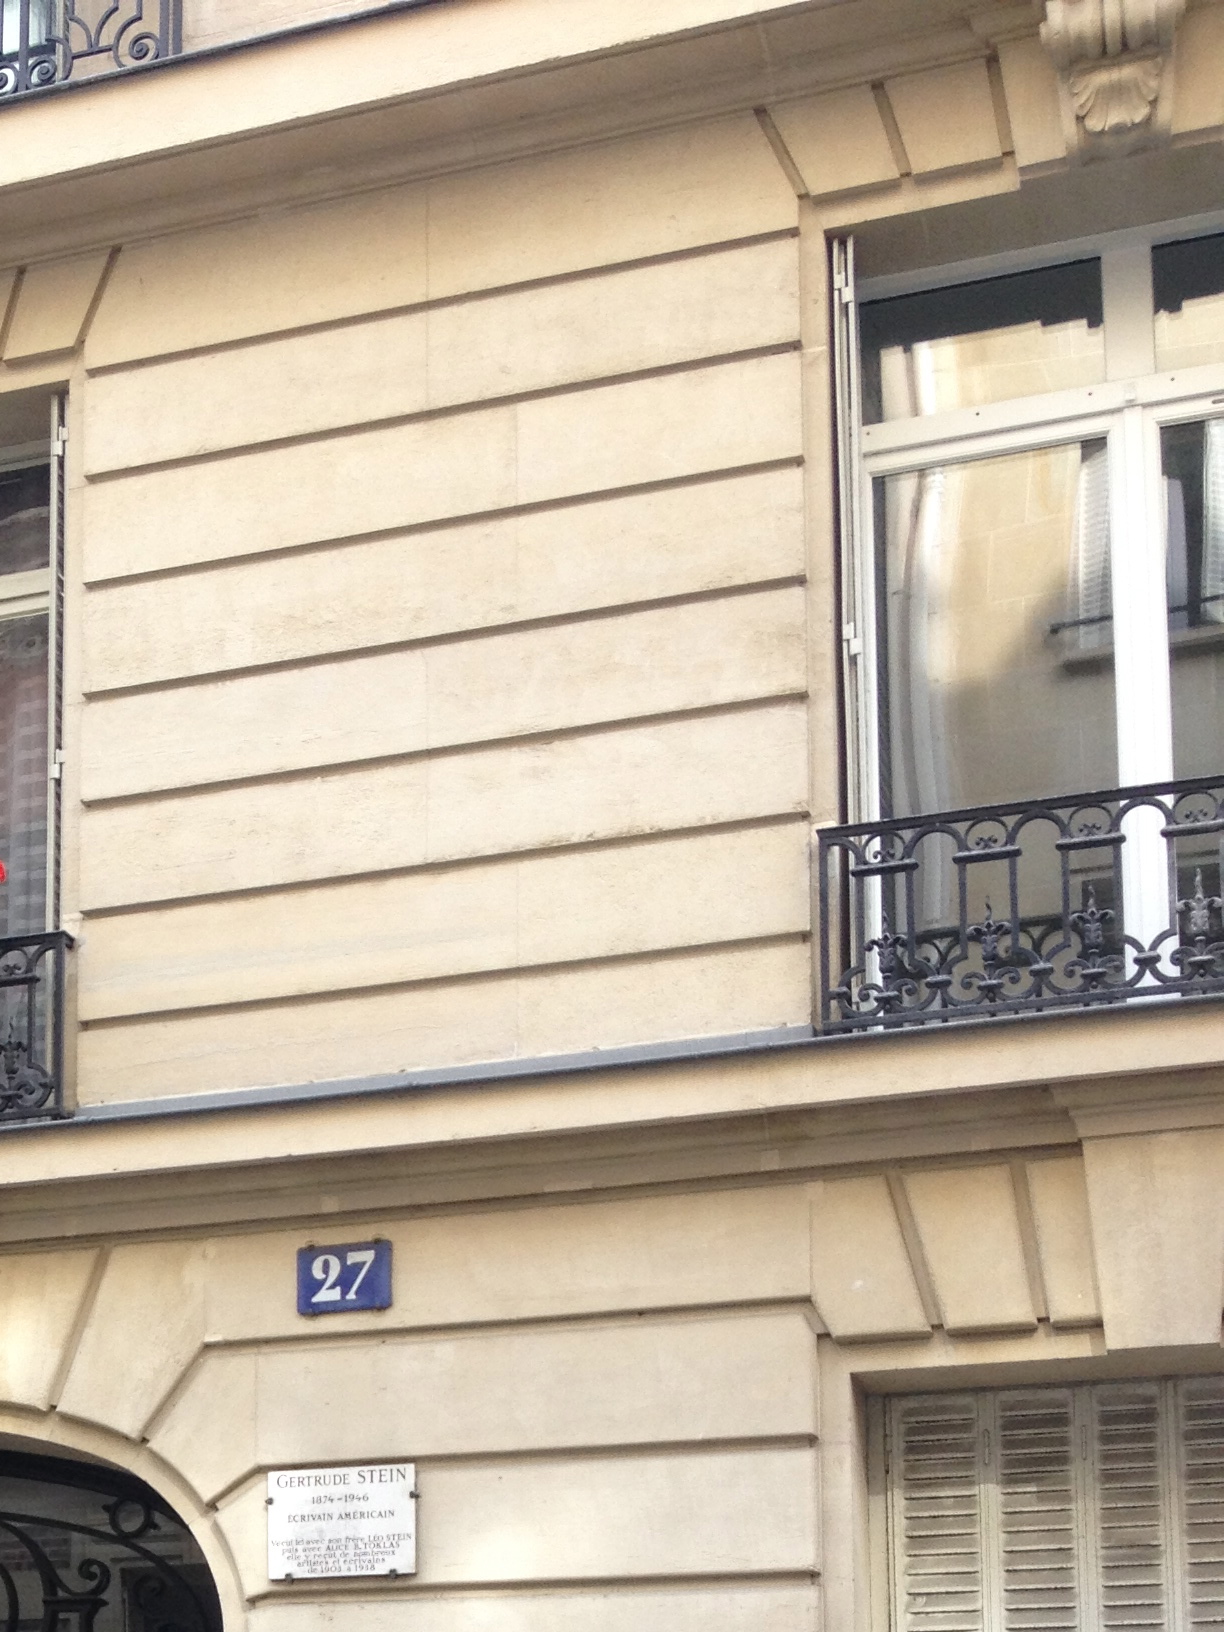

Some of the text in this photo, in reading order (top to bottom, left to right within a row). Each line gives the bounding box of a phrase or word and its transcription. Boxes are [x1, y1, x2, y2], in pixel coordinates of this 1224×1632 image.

[311, 1249, 376, 1303] 27
[276, 1467, 407, 1488] GERTRUDE STEIN
[386, 1532, 412, 1541] STEIN
[363, 1540, 400, 1550] TOKLAS
